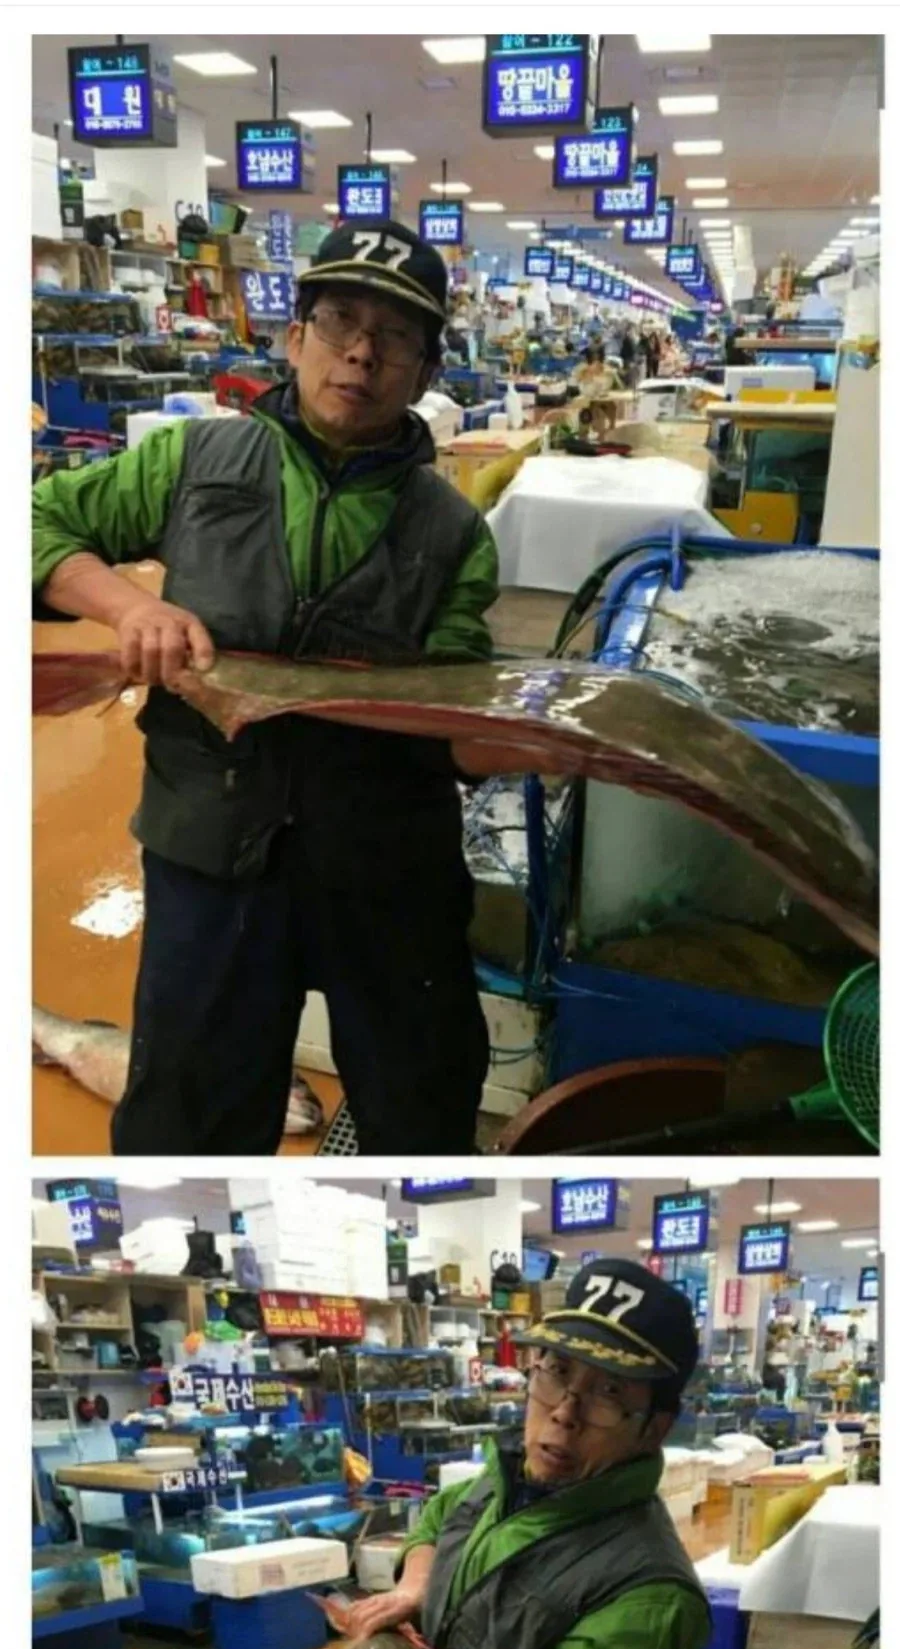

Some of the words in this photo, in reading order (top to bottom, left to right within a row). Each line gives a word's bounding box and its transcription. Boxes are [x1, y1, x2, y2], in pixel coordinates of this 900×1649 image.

[352, 231, 413, 273] 77
[579, 1275, 645, 1323] 77
[194, 1376, 255, 1411] 국제수산
